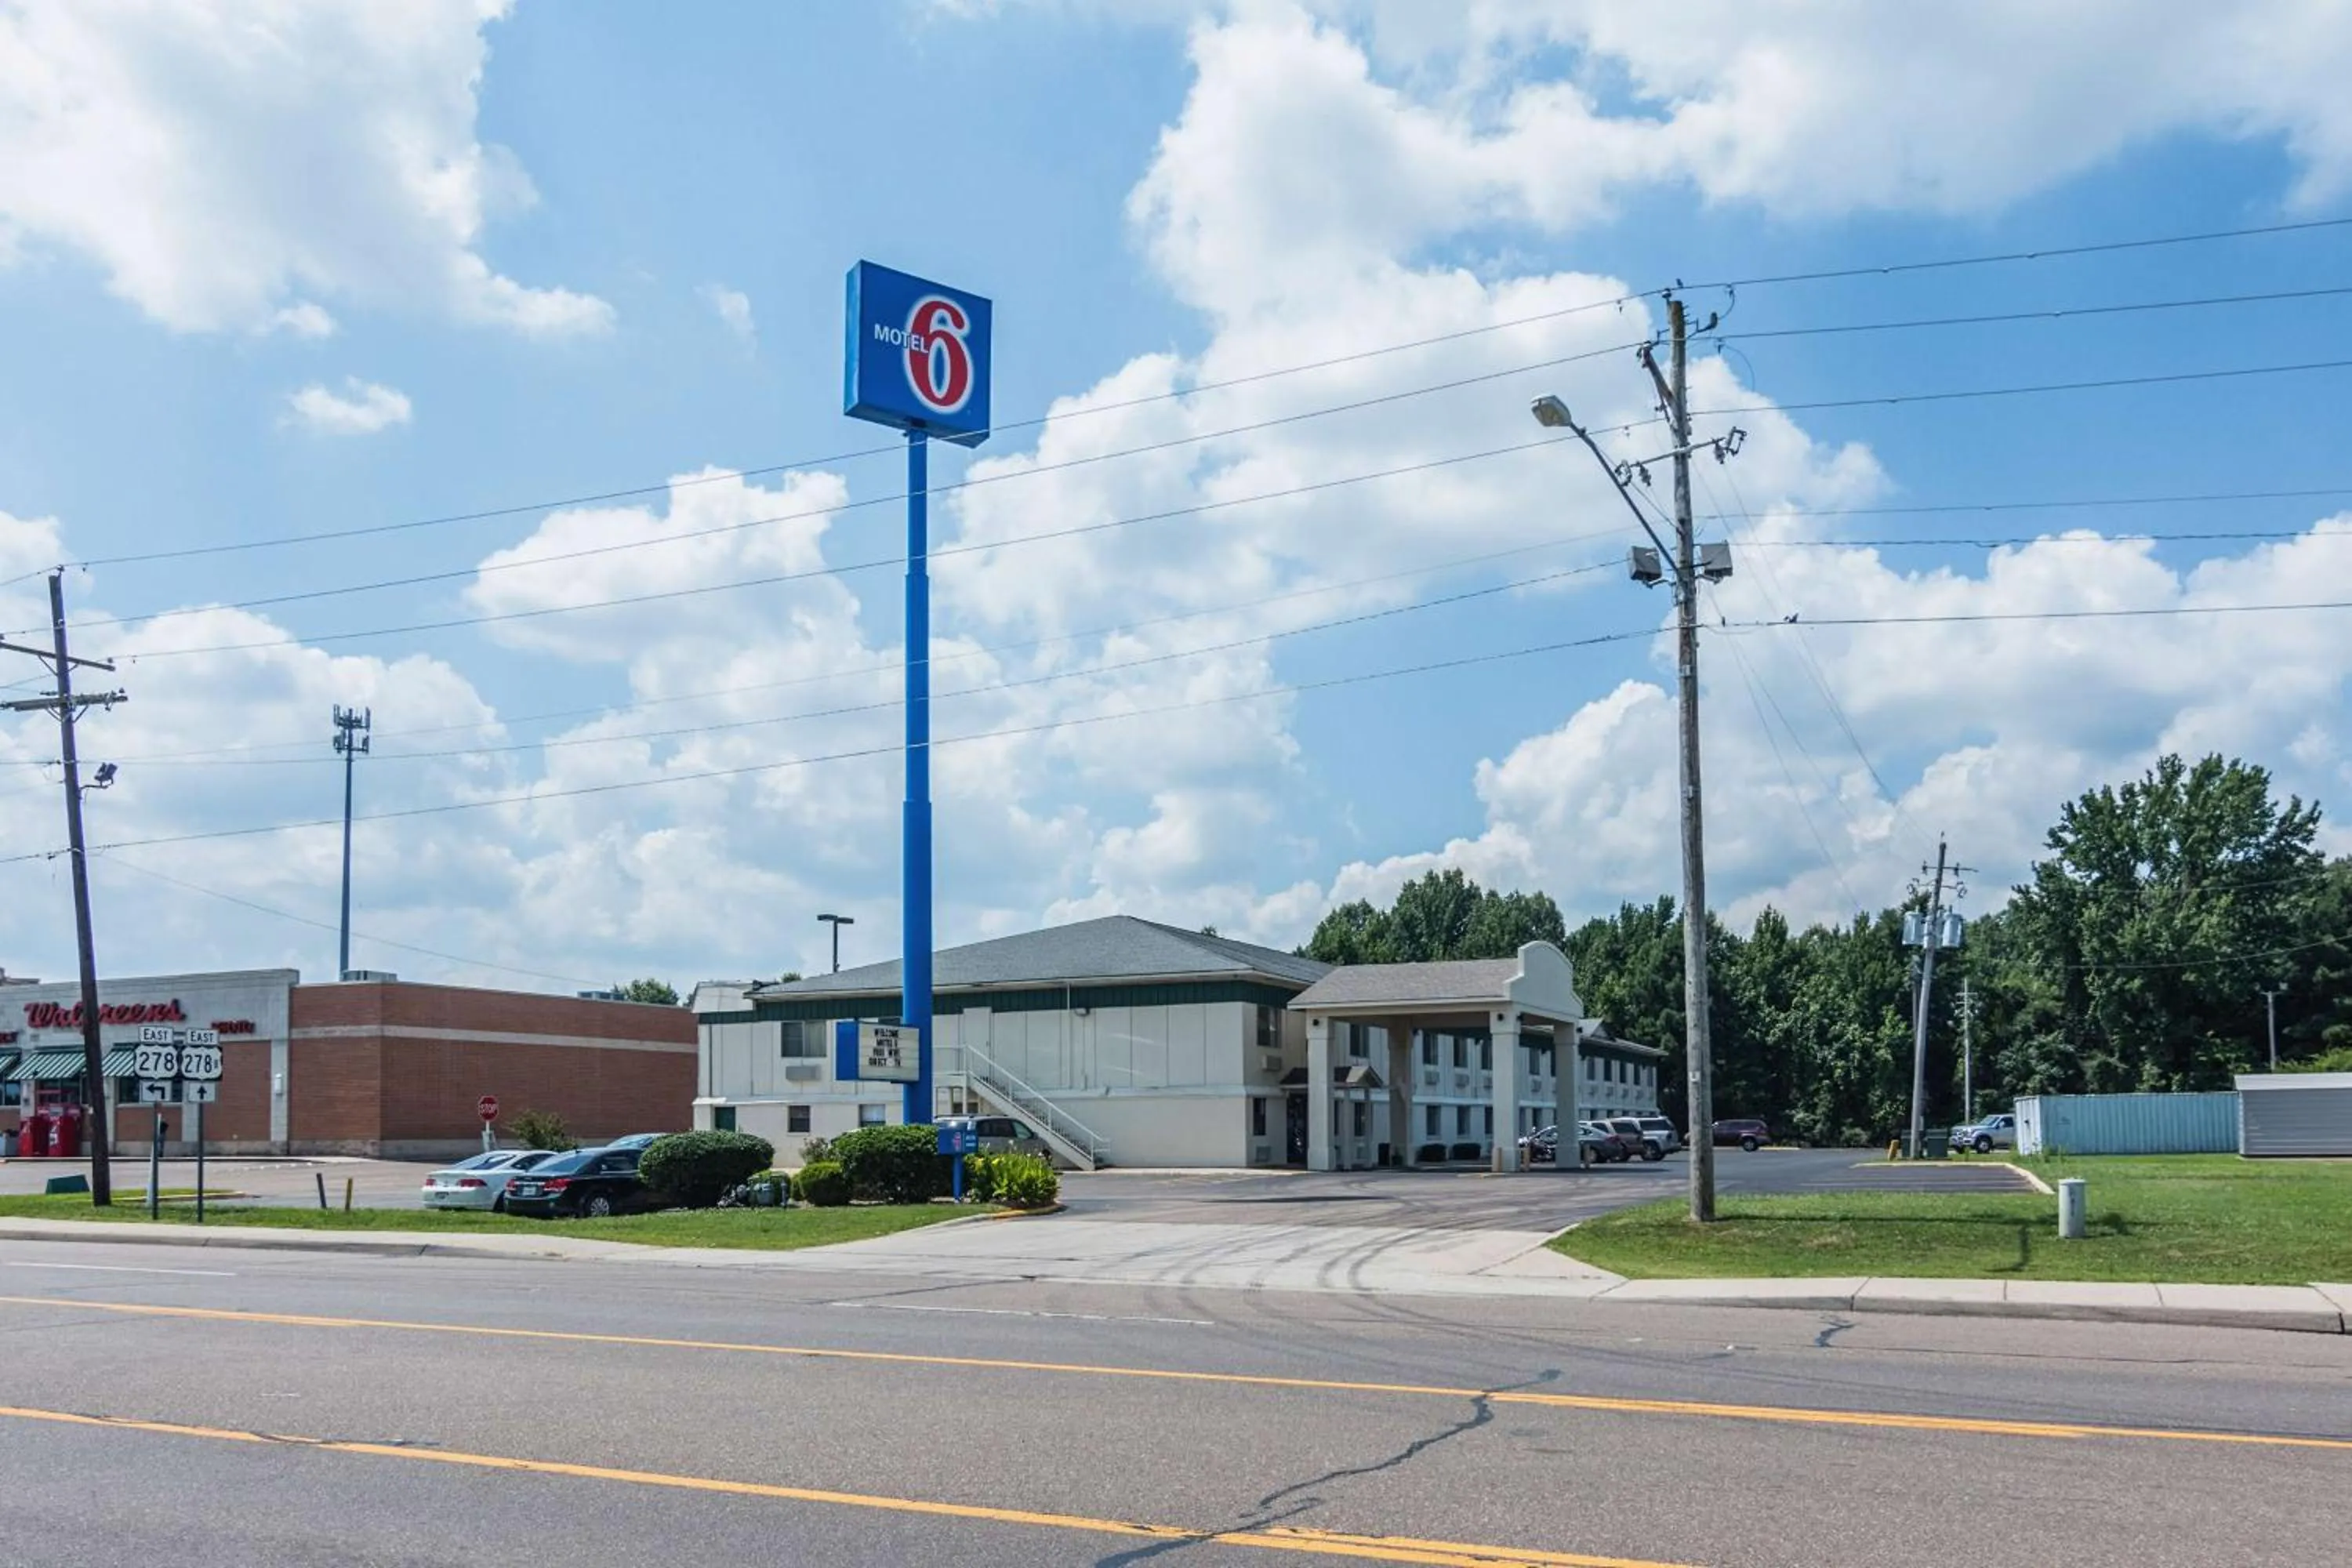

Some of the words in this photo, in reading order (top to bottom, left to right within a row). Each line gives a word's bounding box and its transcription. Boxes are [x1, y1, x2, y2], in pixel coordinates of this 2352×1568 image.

[874, 323, 930, 354] MOTEL
[903, 295, 975, 414] 6
[24, 998, 187, 1035] Walreens
[143, 1029, 169, 1042] EAST
[191, 1031, 214, 1043] EAST
[139, 1051, 175, 1072] 278
[479, 1103, 499, 1113] STOP
